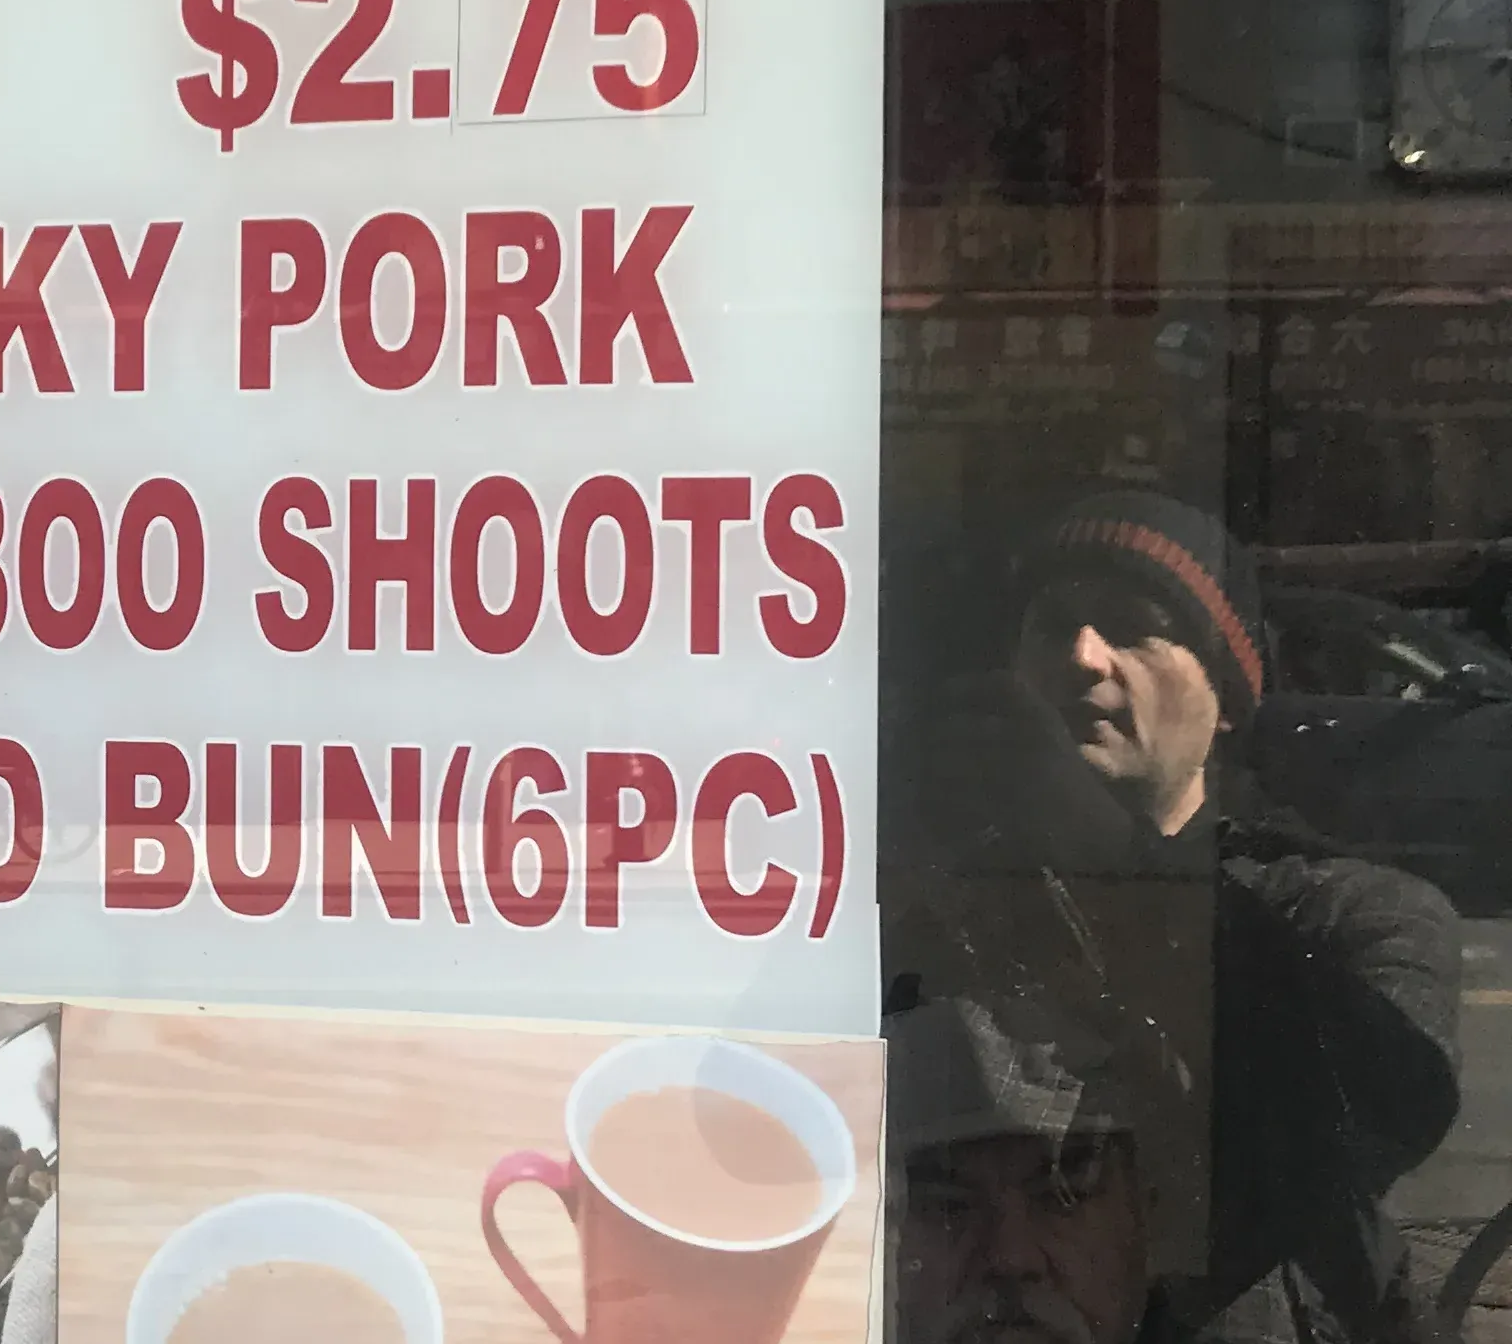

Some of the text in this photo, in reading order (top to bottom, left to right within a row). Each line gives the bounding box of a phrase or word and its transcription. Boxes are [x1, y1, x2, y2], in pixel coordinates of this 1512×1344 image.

[239, 205, 694, 391] PORK
[255, 474, 847, 659] SHOOTS
[105, 741, 846, 939] BUN(6PC)
